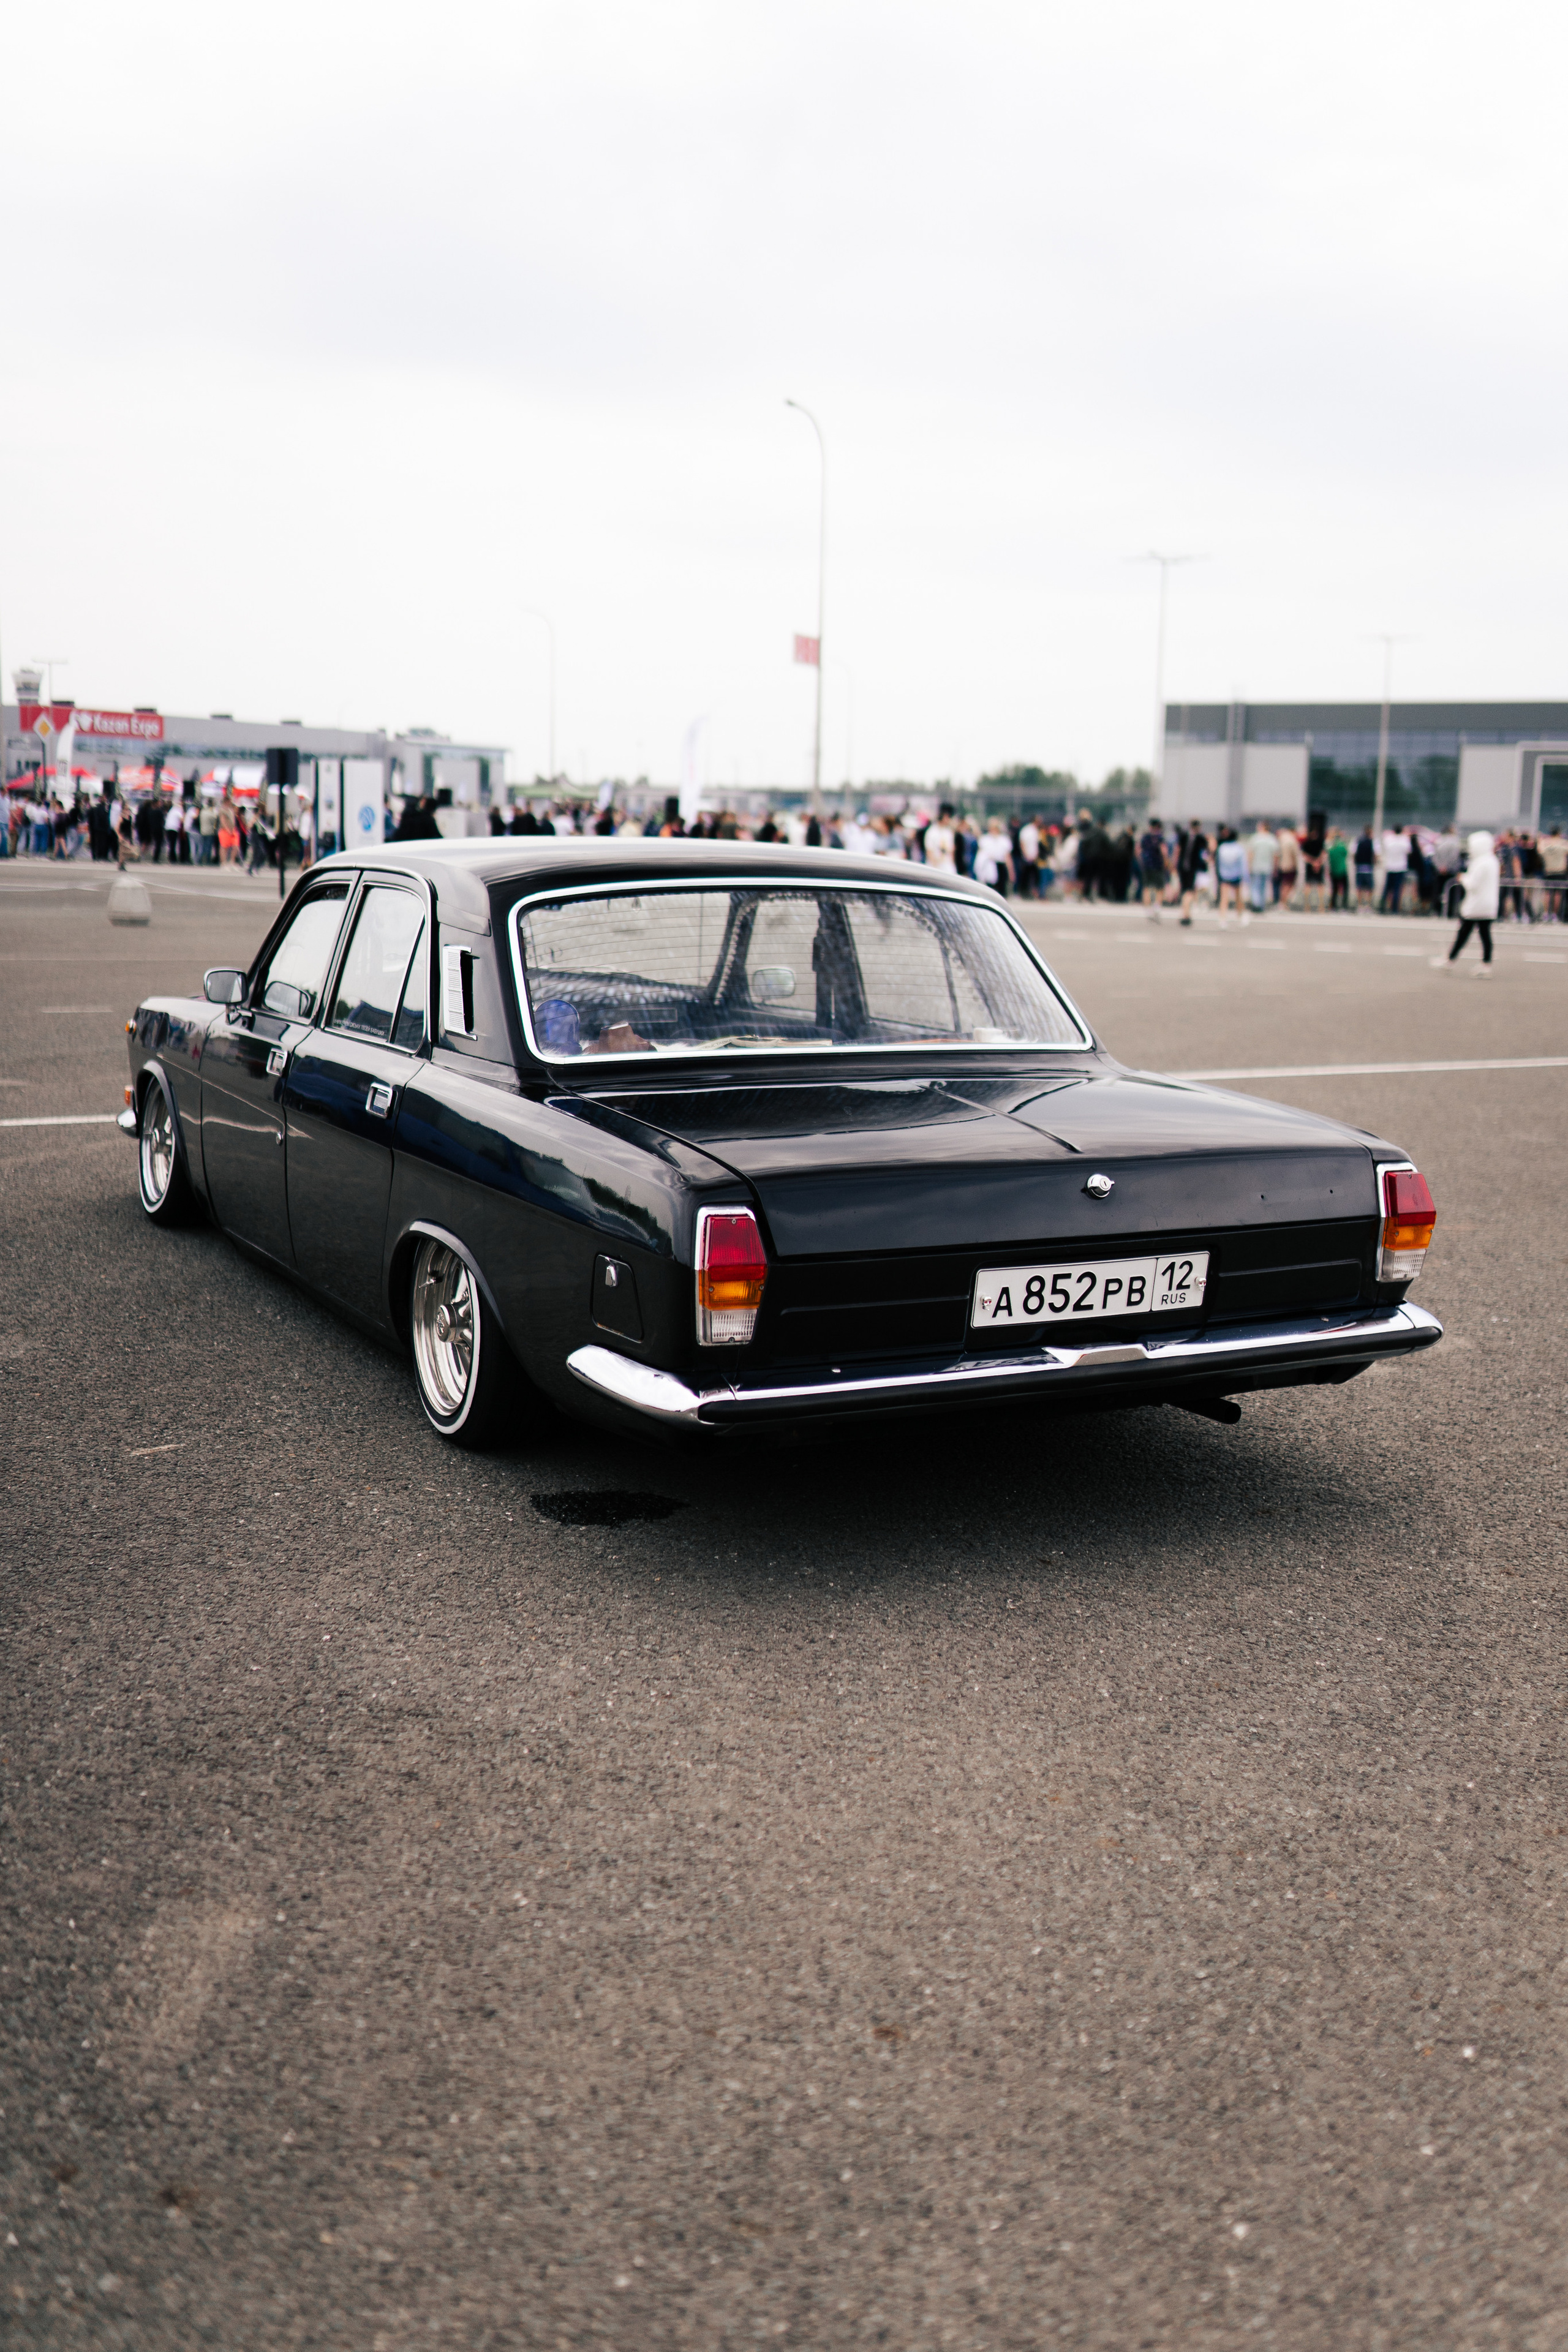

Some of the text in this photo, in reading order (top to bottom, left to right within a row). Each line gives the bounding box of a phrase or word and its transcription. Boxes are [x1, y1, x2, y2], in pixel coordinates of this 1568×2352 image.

[93, 715, 159, 740] Kazan Expo
[1161, 1261, 1193, 1291] 12
[1161, 1293, 1186, 1305] RUS
